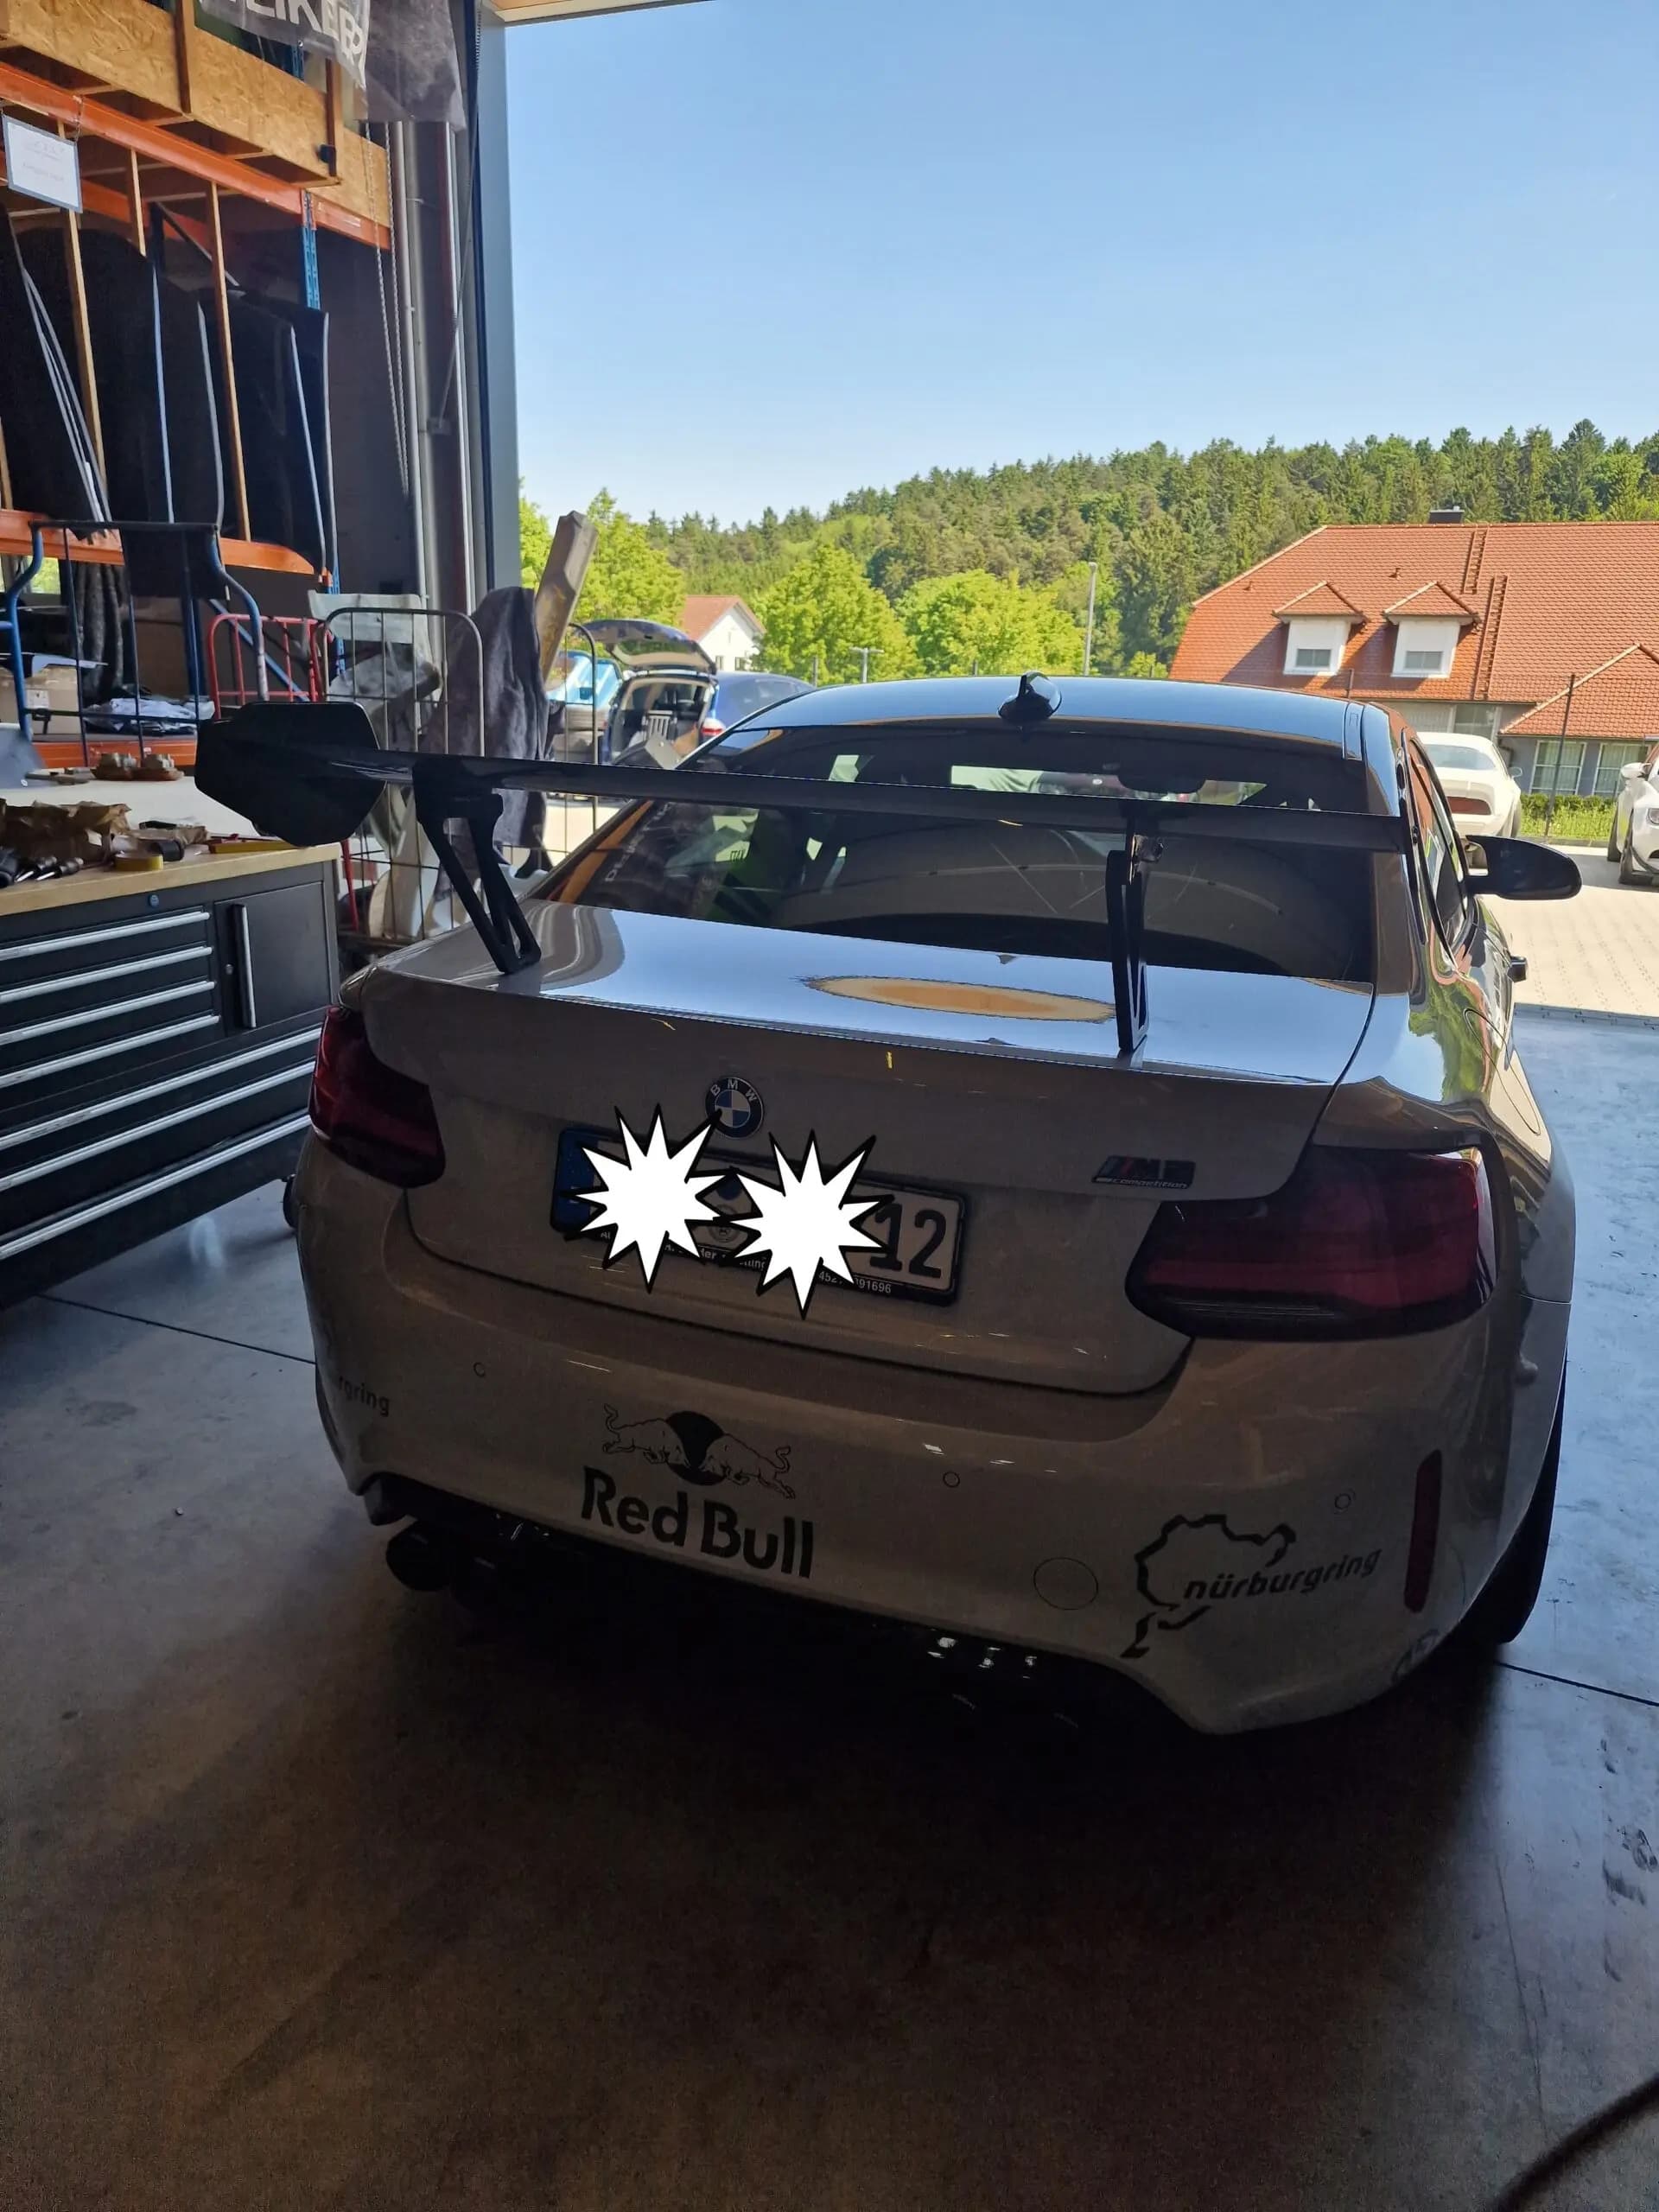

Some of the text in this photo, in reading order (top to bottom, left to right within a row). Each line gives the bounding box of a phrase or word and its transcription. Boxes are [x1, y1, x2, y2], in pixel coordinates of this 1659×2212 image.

[710, 1077, 757, 1102] BMW
[869, 1203, 947, 1279] 12
[581, 1465, 814, 1580] Red Bull
[1183, 1548, 1382, 1599] nürburgring
